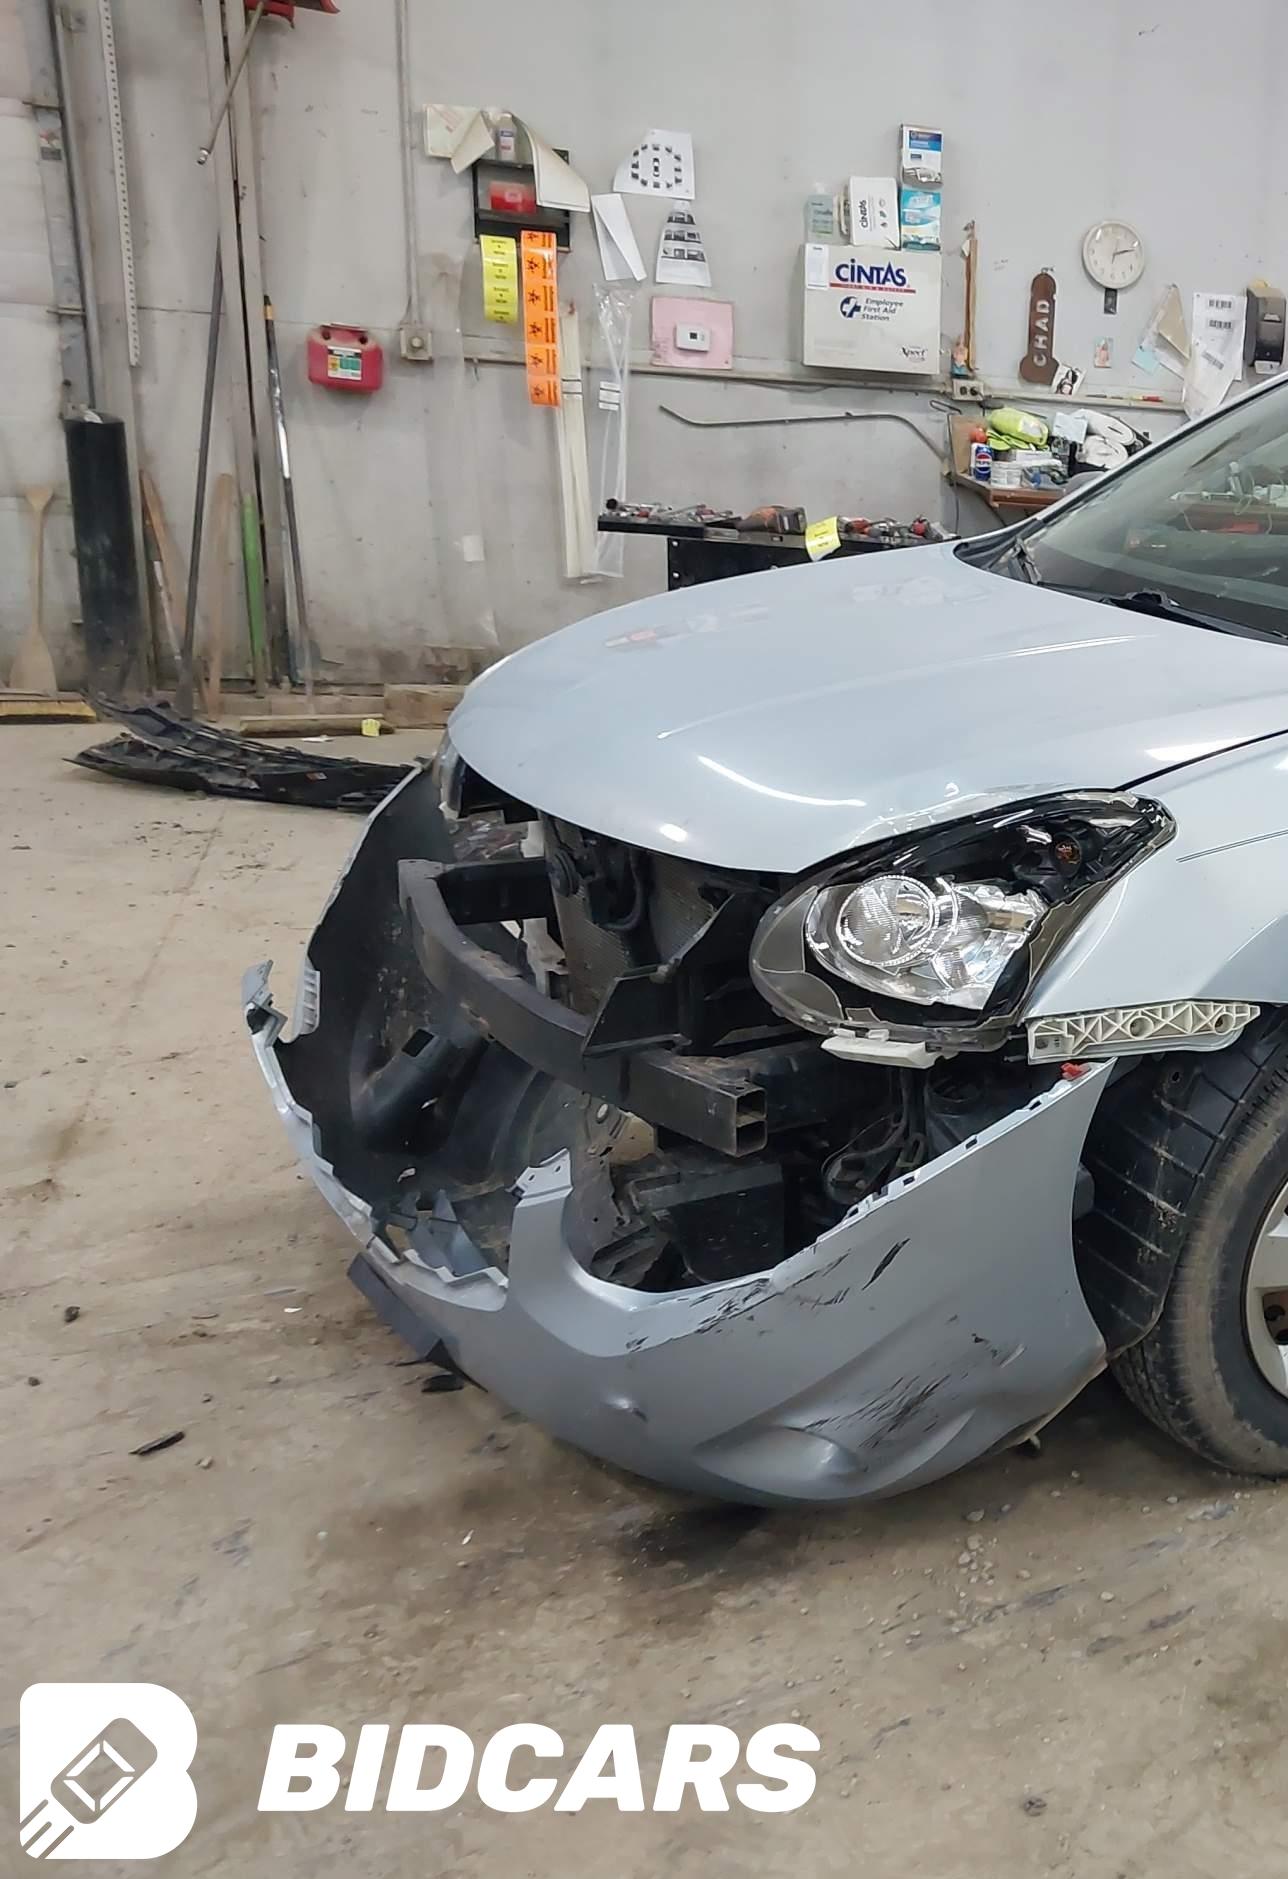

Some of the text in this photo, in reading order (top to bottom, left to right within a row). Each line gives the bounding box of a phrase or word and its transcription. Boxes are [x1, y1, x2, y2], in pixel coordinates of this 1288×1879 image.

[859, 200, 869, 228] CINTAS
[835, 258, 907, 287] CINTAS
[863, 305, 897, 314] First Aid
[865, 297, 904, 307] Employee
[861, 313, 890, 321] Station
[1032, 300, 1050, 367] CHAD
